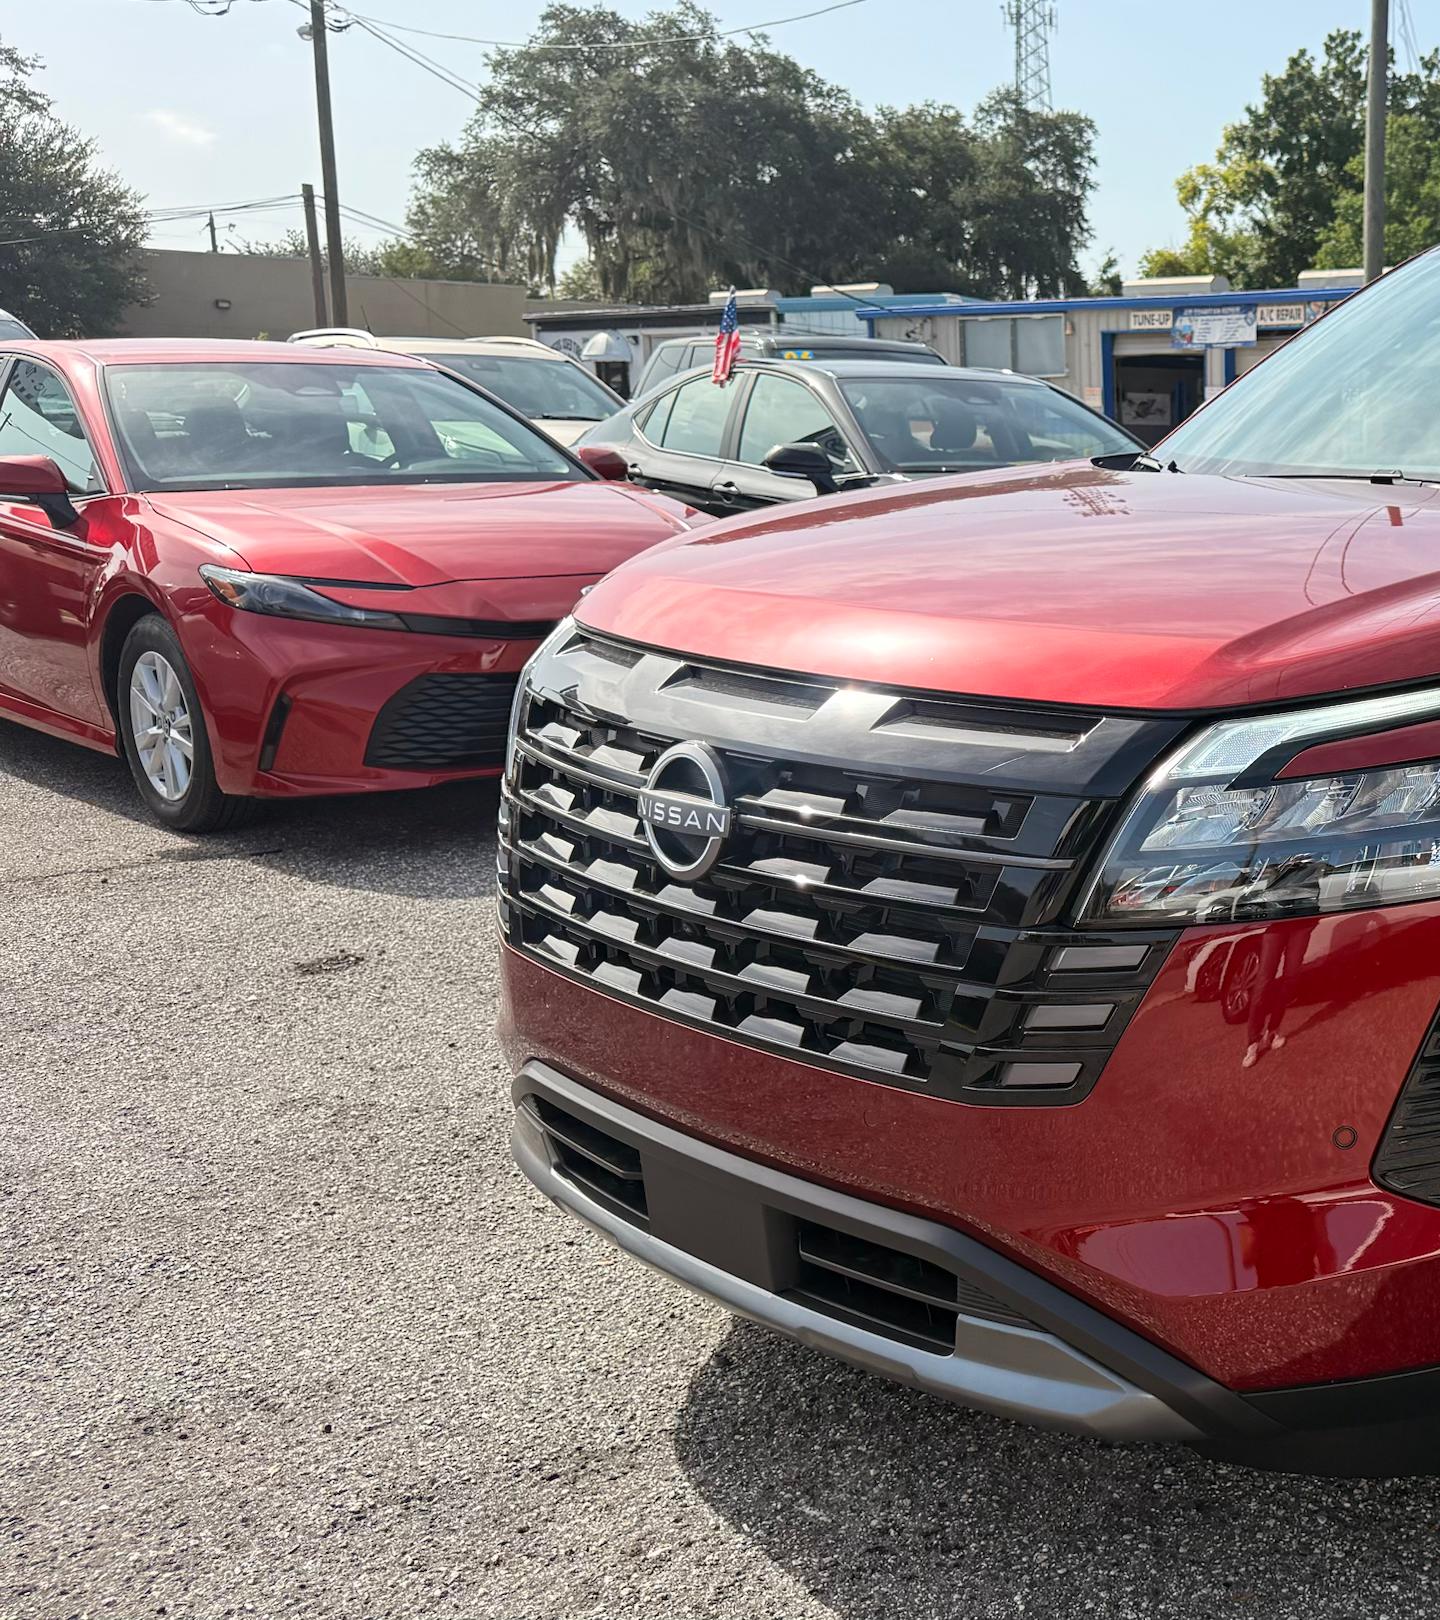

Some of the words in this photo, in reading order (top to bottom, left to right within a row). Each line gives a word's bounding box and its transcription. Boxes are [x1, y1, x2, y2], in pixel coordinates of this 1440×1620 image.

[1133, 313, 1170, 326] TUNE-UP
[1260, 308, 1274, 322] A/C
[1276, 307, 1302, 321] REPAIR
[640, 795, 726, 832] NISSAN
